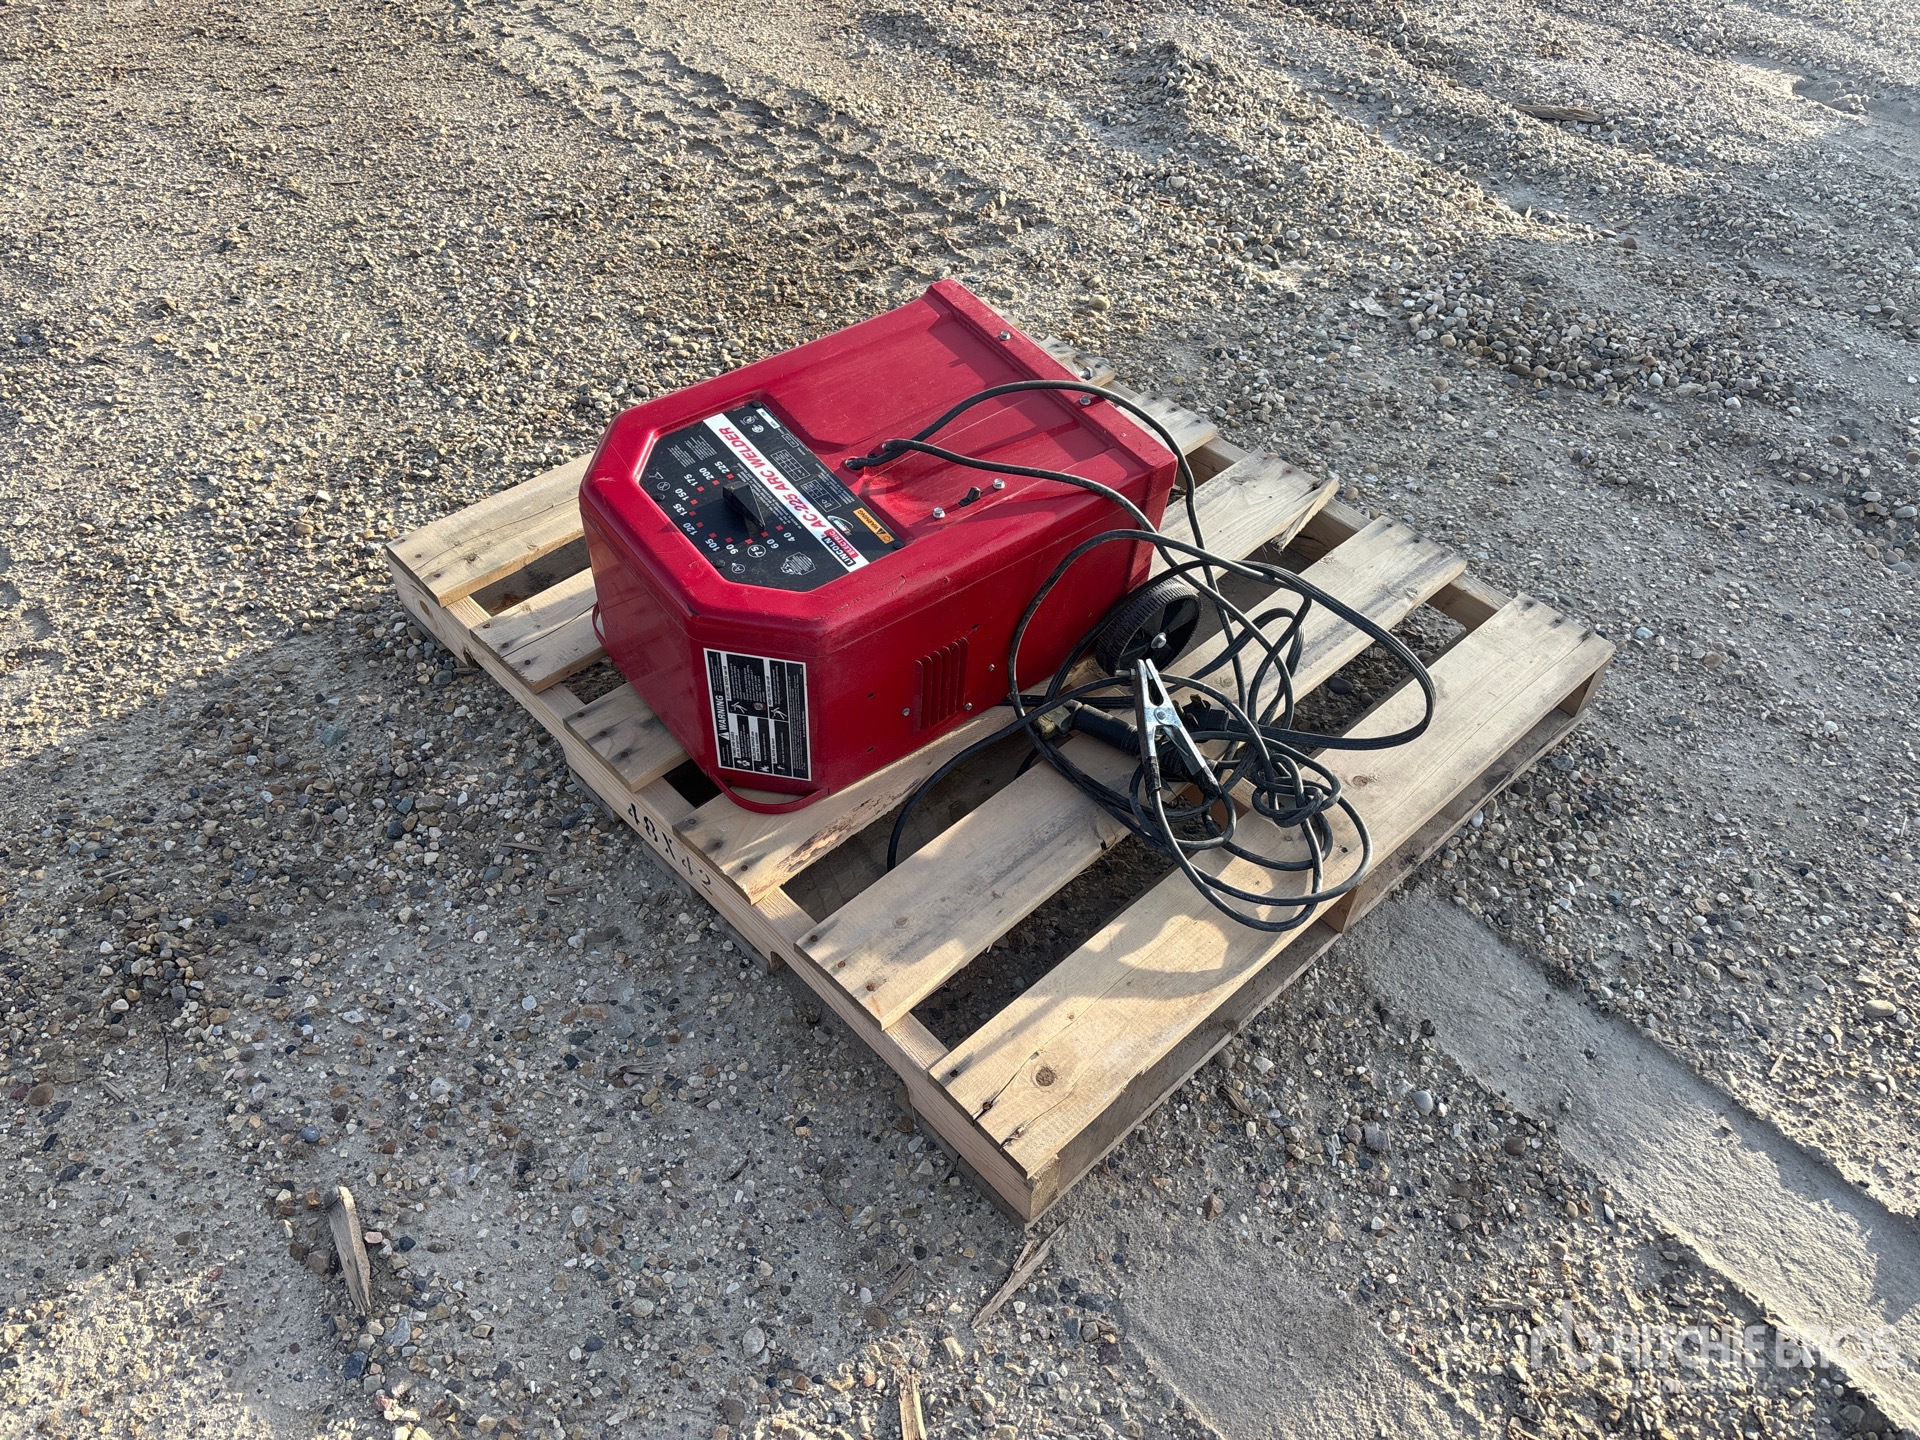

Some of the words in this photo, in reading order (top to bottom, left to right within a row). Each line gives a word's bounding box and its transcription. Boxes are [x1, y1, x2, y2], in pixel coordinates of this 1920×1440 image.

[719, 427, 767, 469] WELDER
[699, 467, 715, 481] 200
[714, 461, 730, 474] 225
[684, 473, 698, 487] 175
[760, 470, 790, 491] ARC
[675, 488, 689, 501] 150
[673, 503, 688, 516] 135
[783, 494, 827, 529] AC-225
[857, 510, 879, 531] WARNING
[683, 522, 698, 536] 120
[766, 538, 779, 549] 60
[783, 532, 796, 542] 40
[828, 530, 857, 558] ELECTRIC
[705, 538, 721, 552] 105
[725, 544, 739, 555] 90
[751, 546, 763, 556] 75
[824, 537, 853, 565] LINCOLN
[715, 695, 728, 731] WARNING
